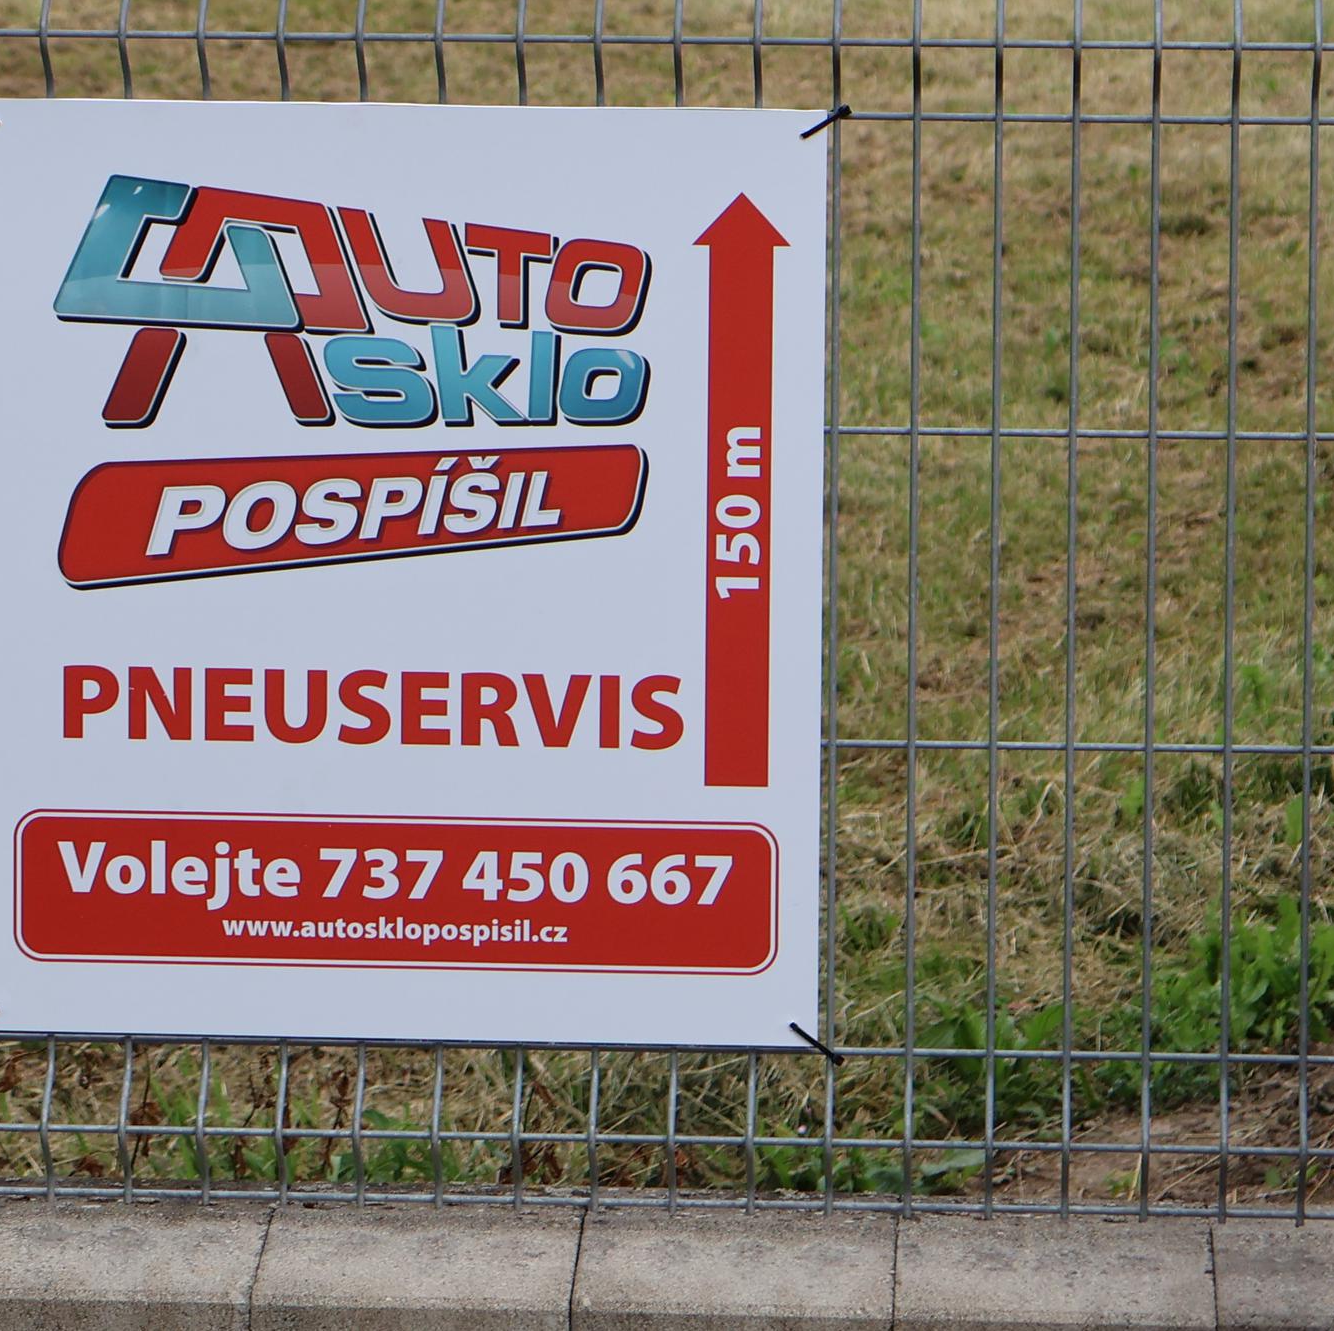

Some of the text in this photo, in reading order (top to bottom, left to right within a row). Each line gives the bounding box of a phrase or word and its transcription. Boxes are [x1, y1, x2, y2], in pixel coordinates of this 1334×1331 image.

[145, 454, 562, 557] POSPÍŠIL
[715, 425, 761, 599] 150 m
[62, 665, 685, 751] PNEUSERVIS
[57, 840, 734, 911] Volejte 737 450 667
[222, 916, 568, 947] www.autosklopospisil.cz
